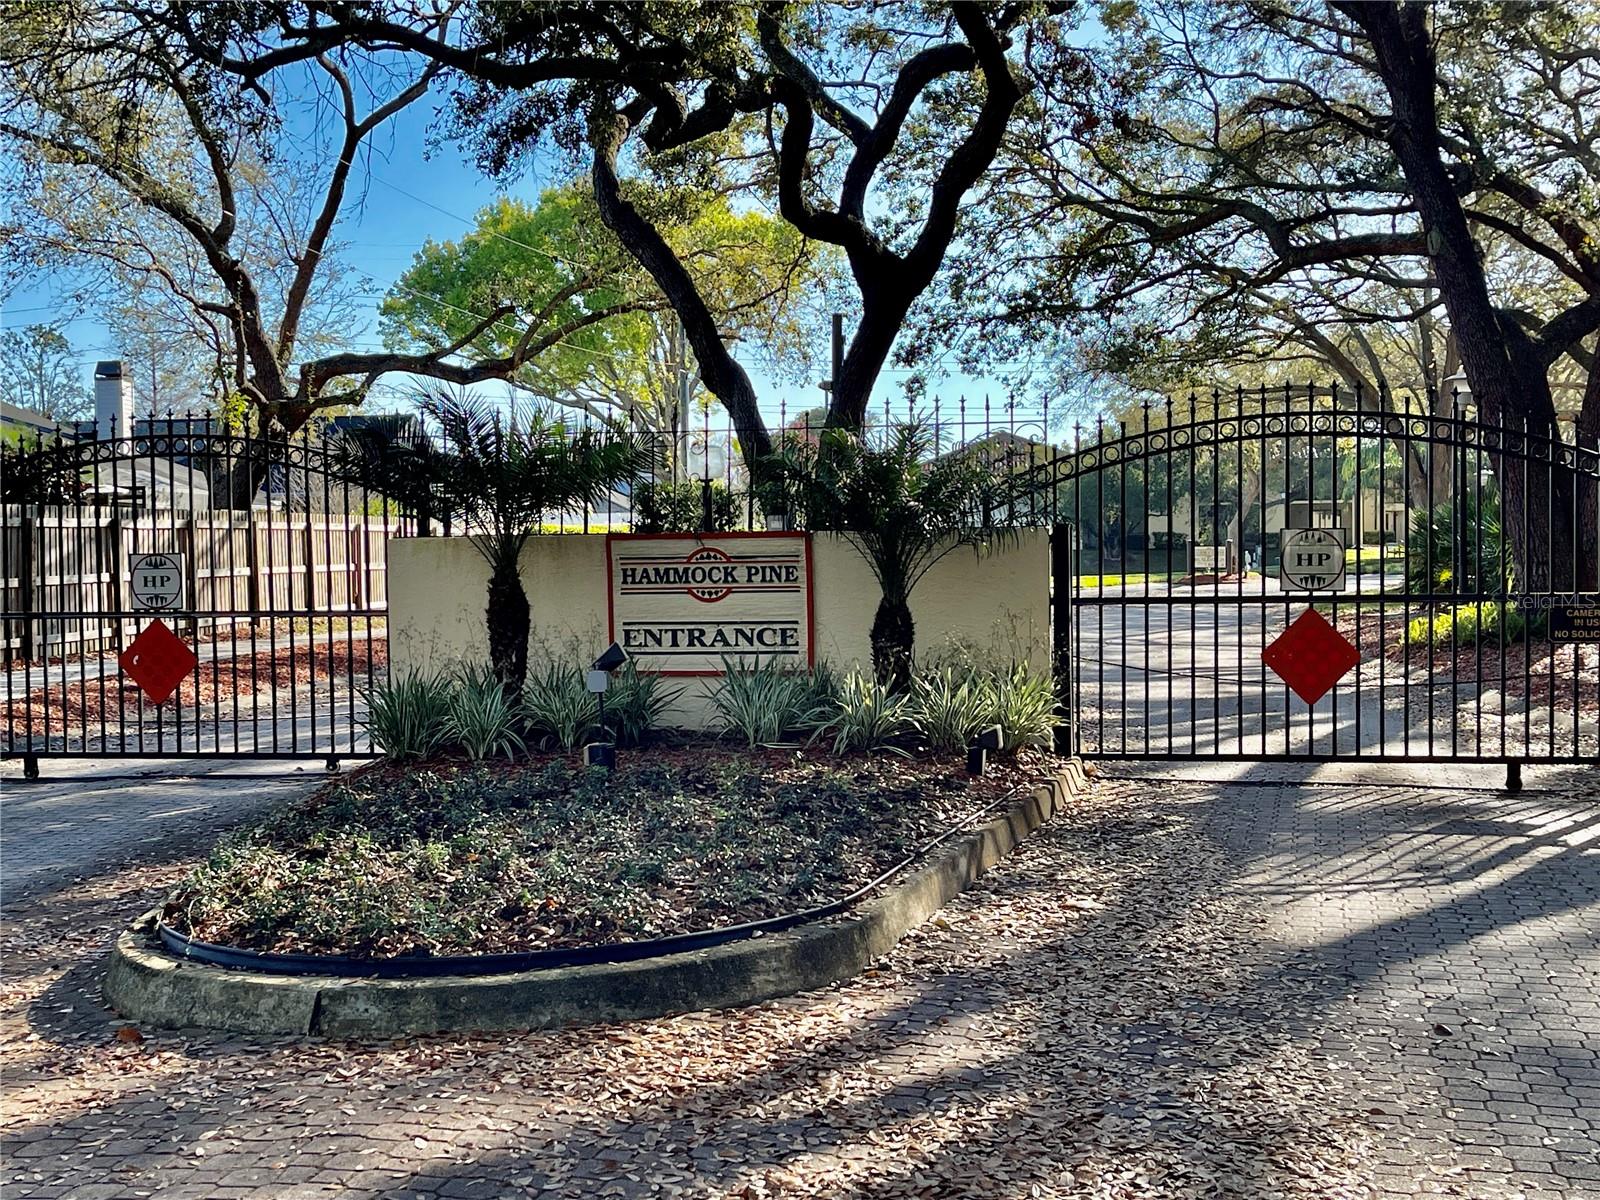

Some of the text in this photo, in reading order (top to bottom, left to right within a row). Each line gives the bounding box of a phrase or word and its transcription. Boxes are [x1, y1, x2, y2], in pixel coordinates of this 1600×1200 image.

[1296, 553, 1331, 567] HP
[621, 565, 798, 584] HAMMOCK PINE
[143, 575, 171, 588] HP
[1574, 618, 1584, 626] IN
[623, 628, 799, 648] ENTRANCE
[1554, 630, 1569, 638] NO
